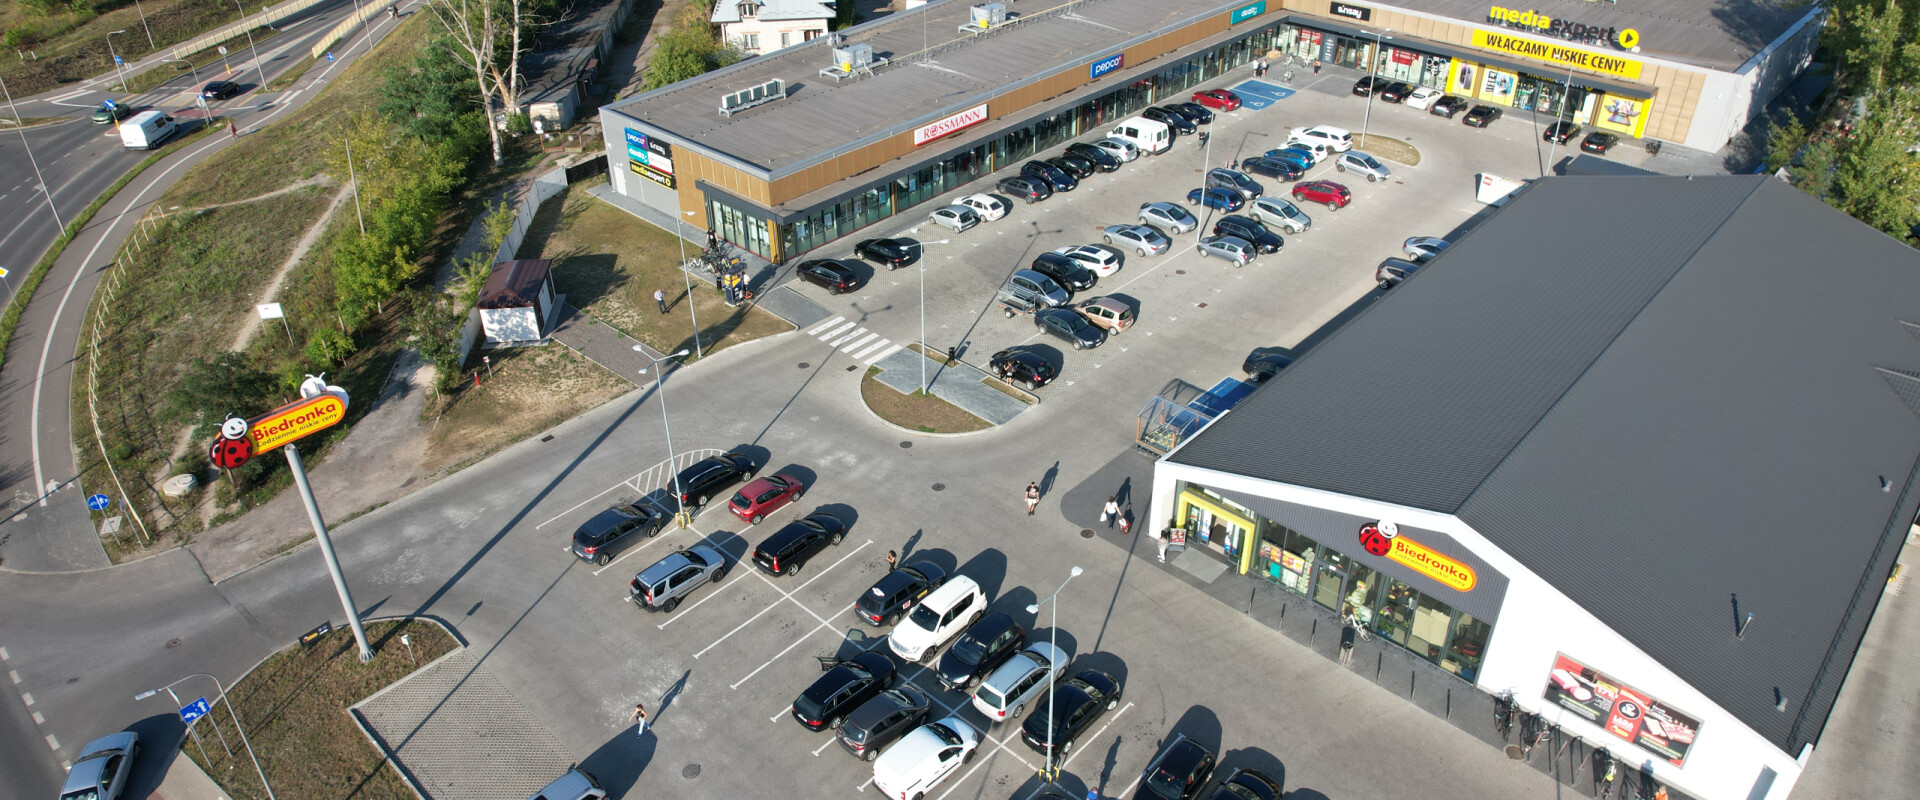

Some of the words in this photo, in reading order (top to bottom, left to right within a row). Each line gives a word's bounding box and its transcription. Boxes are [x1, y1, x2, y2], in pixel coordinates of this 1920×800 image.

[1338, 5, 1362, 19] sinsay
[1490, 6, 1616, 41] mediaexpert
[1095, 57, 1120, 75] pepco
[1487, 34, 1549, 58] WŁĄCZAMY
[1551, 47, 1588, 65] NISKIE
[1591, 56, 1626, 73] CENY!
[923, 109, 980, 139] ROSSMANN
[252, 403, 336, 442] Biedronka
[256, 428, 297, 448] Codziennie
[299, 420, 319, 431] niskie
[321, 412, 338, 423] ceny
[1396, 541, 1468, 581] Biedronka
